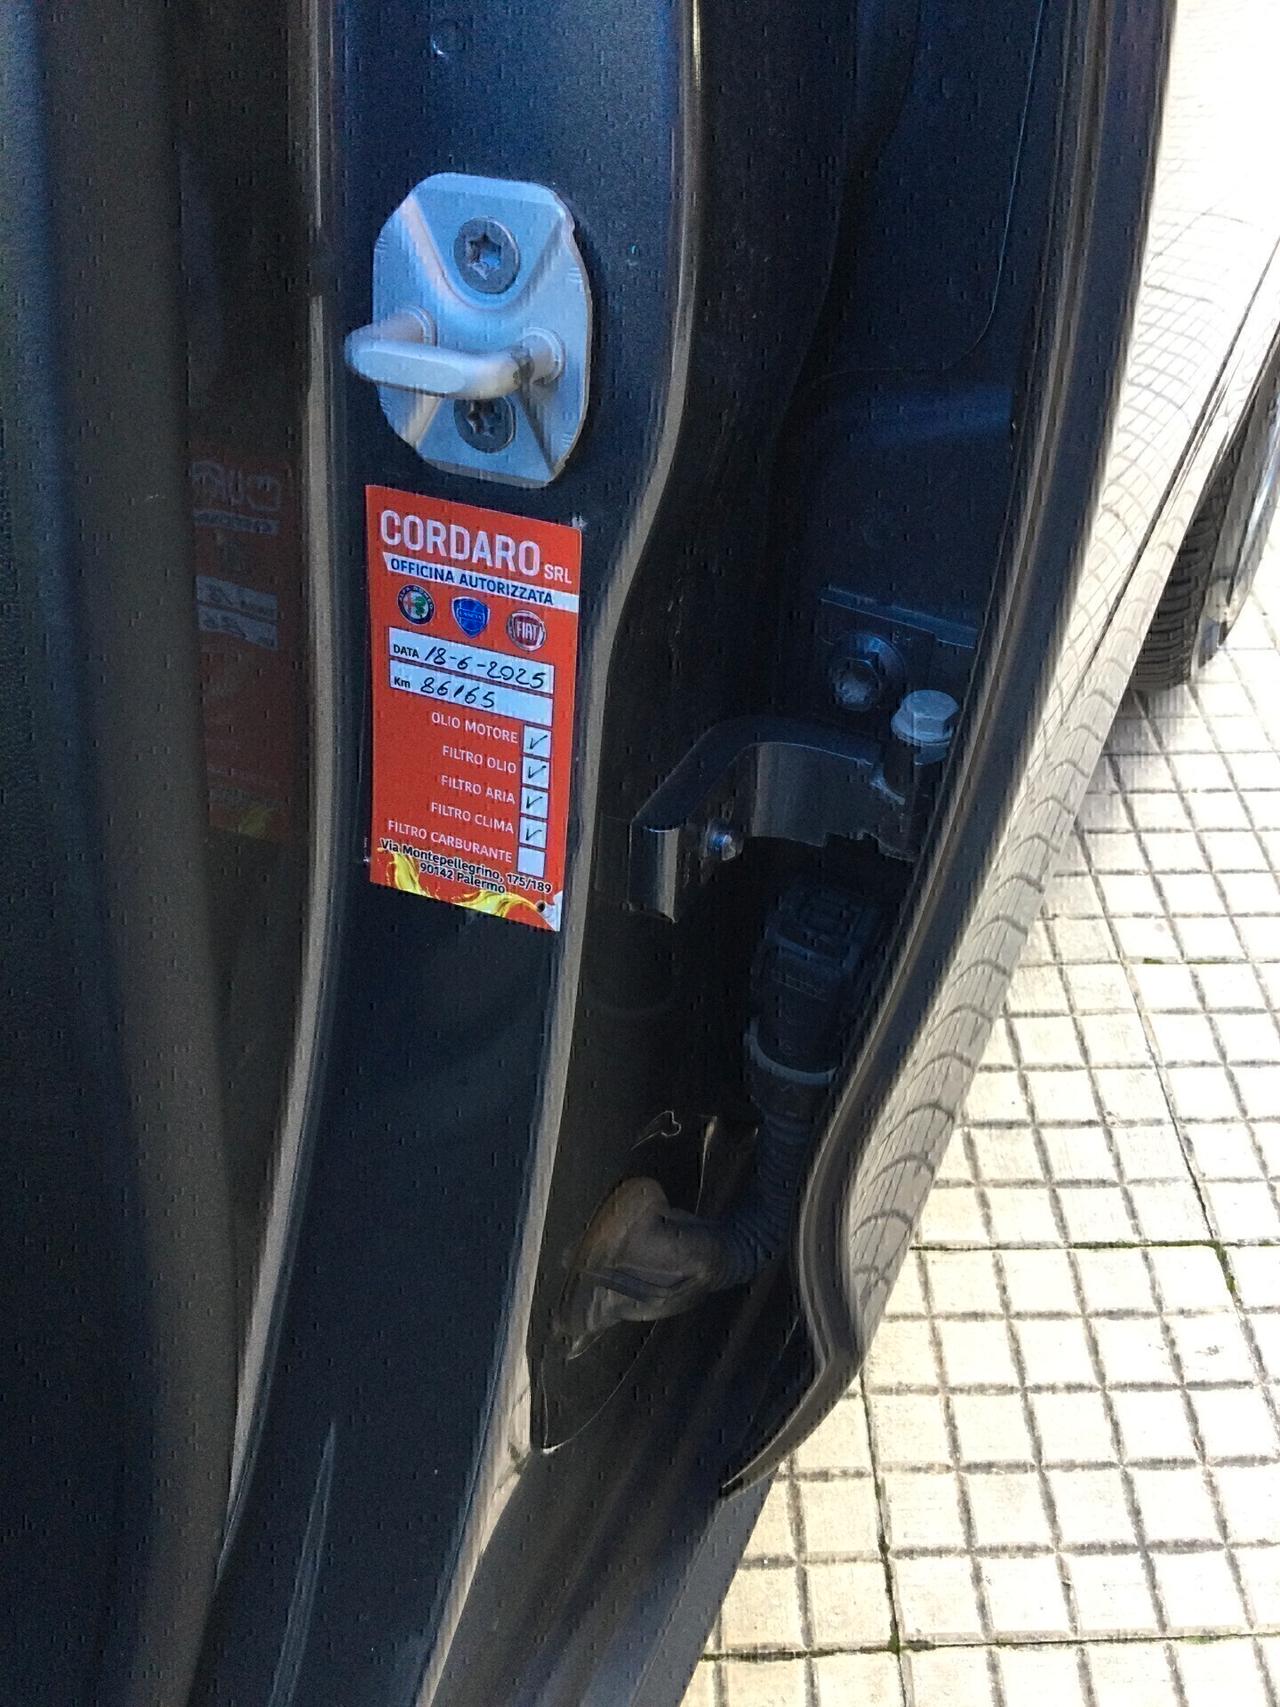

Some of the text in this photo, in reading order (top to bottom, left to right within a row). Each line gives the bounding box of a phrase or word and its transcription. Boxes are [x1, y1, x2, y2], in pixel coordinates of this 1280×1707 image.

[380, 509, 572, 584] CORDARO SRL
[390, 557, 553, 605] OFFICINA AUTORIZZATA
[515, 620, 538, 642] FIAT
[393, 643, 420, 659] DATA
[393, 675, 411, 689] Km
[420, 676, 495, 708] 86165
[431, 712, 518, 744] OLIO MOTORE
[442, 745, 517, 774] FILTRO OLIO
[440, 775, 516, 804] FILTRO ARIA
[431, 802, 514, 834] FILTRO CLIMA
[387, 820, 513, 863] FILTRO CARBURANTE
[381, 838, 552, 893] Via Montepellegrino, 175/189
[420, 862, 506, 894] 90142 Palermo
